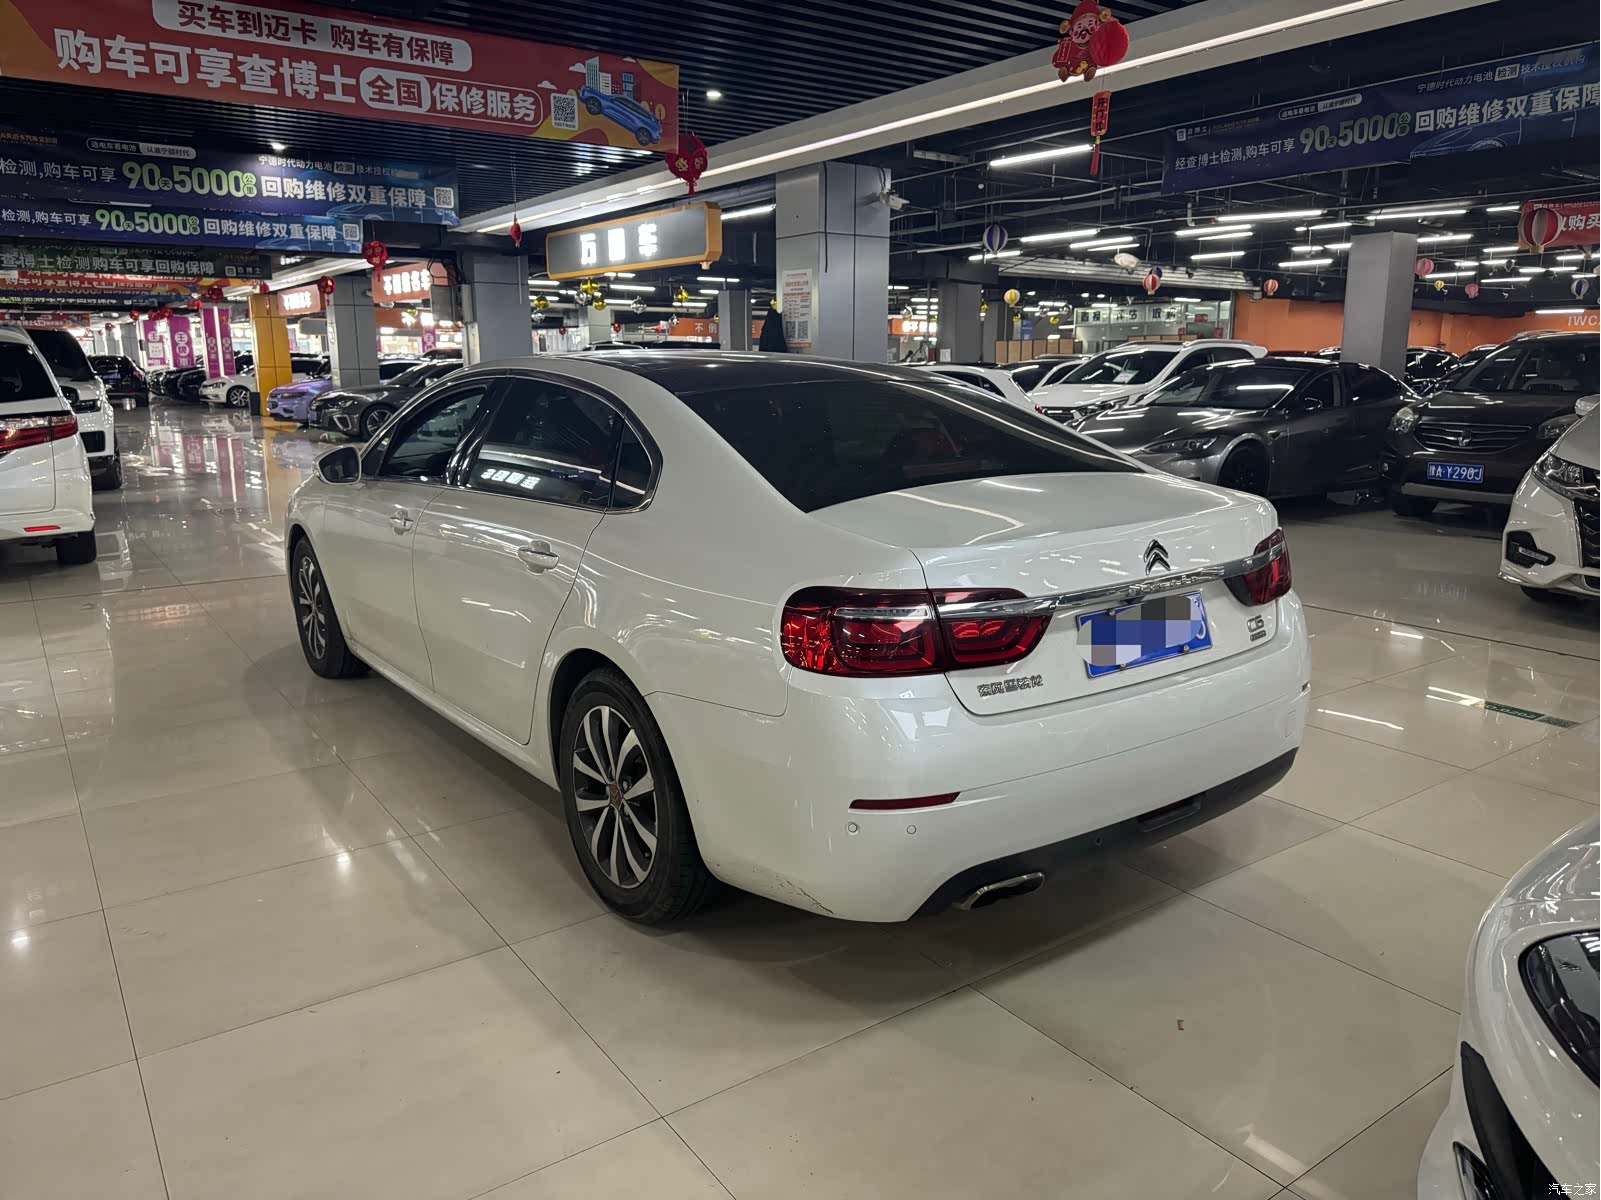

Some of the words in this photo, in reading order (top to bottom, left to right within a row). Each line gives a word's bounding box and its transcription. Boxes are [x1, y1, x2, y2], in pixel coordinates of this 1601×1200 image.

[177, 1, 318, 46] 买车到迈卡
[330, 24, 454, 66] 购车有保障
[53, 28, 357, 104] 购车可享查博士
[366, 74, 425, 109] 全国
[432, 82, 537, 122] 保修服务
[1417, 70, 1493, 94] 宁德时代动力电池
[1413, 82, 1600, 134] 回购维修双重保障
[258, 155, 333, 172] 宁德时代动力电池
[260, 175, 427, 208] 回购维修双重保障
[1, 208, 92, 226] 检测,购车可享
[203, 218, 337, 241] 回购维修双重保障
[1567, 315, 1600, 327] IWC
